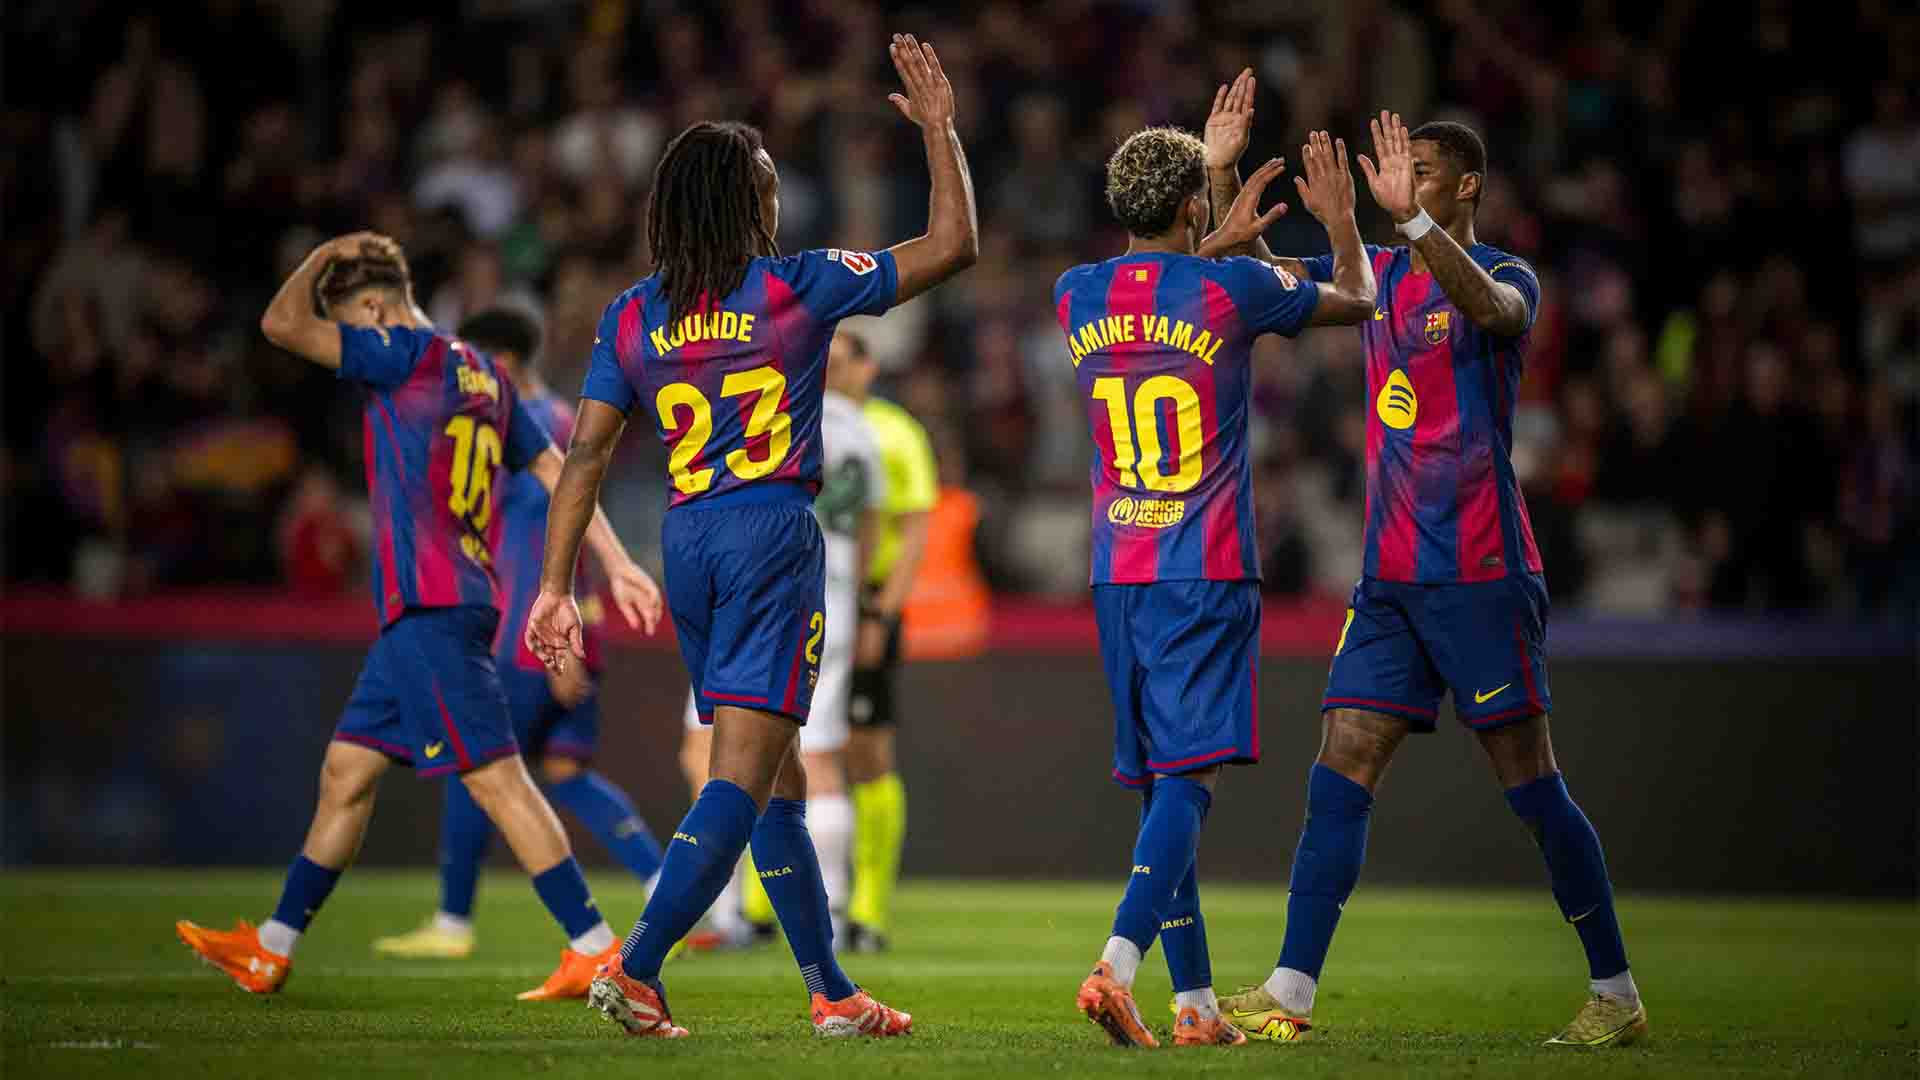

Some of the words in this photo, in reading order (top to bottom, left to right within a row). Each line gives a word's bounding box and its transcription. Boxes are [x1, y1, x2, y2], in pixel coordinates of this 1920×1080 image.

[1141, 314, 1224, 366] YAMAL
[445, 414, 500, 531] 16
[655, 366, 792, 495] 23
[1091, 374, 1204, 493] 10
[1139, 499, 1185, 511] UNHCR
